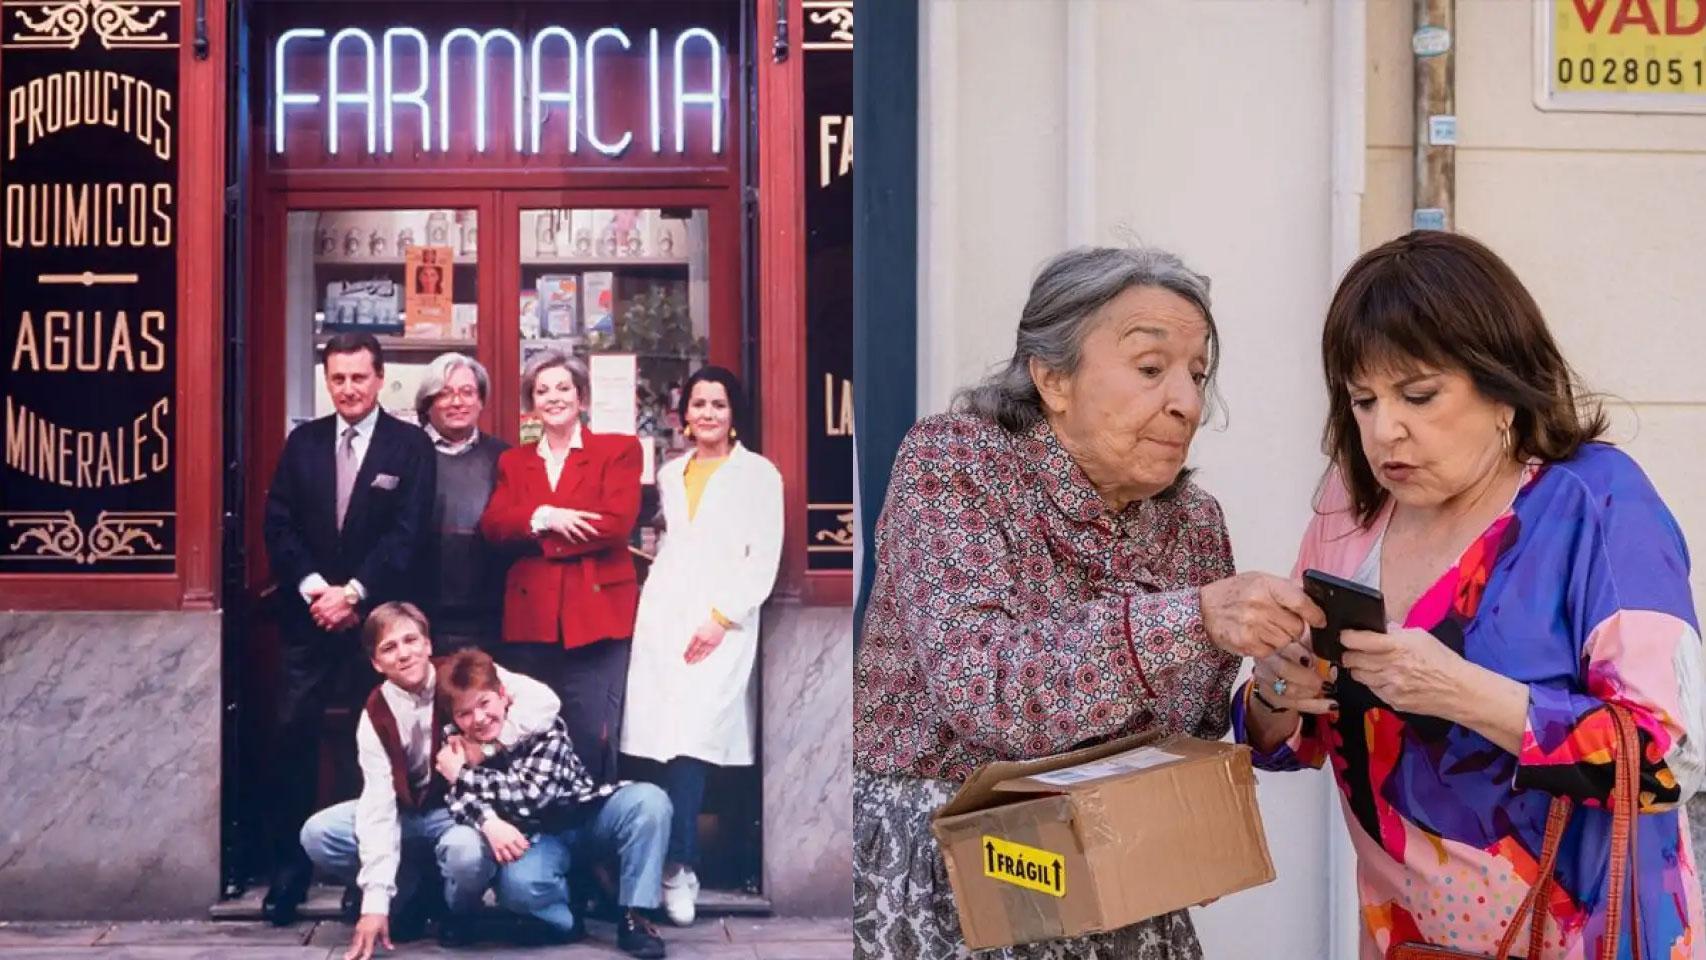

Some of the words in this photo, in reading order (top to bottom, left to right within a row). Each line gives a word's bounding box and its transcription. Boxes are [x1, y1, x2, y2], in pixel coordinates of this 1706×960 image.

[275, 27, 723, 154] FARMACIA
[1558, 57, 1702, 86] 0028051
[9, 70, 171, 161] PRODUCTOS
[6, 183, 171, 248] QUIMICOS
[12, 310, 165, 372] AGUAS
[6, 395, 169, 488] MINERALES
[997, 852, 1051, 886] FRÁGIL
